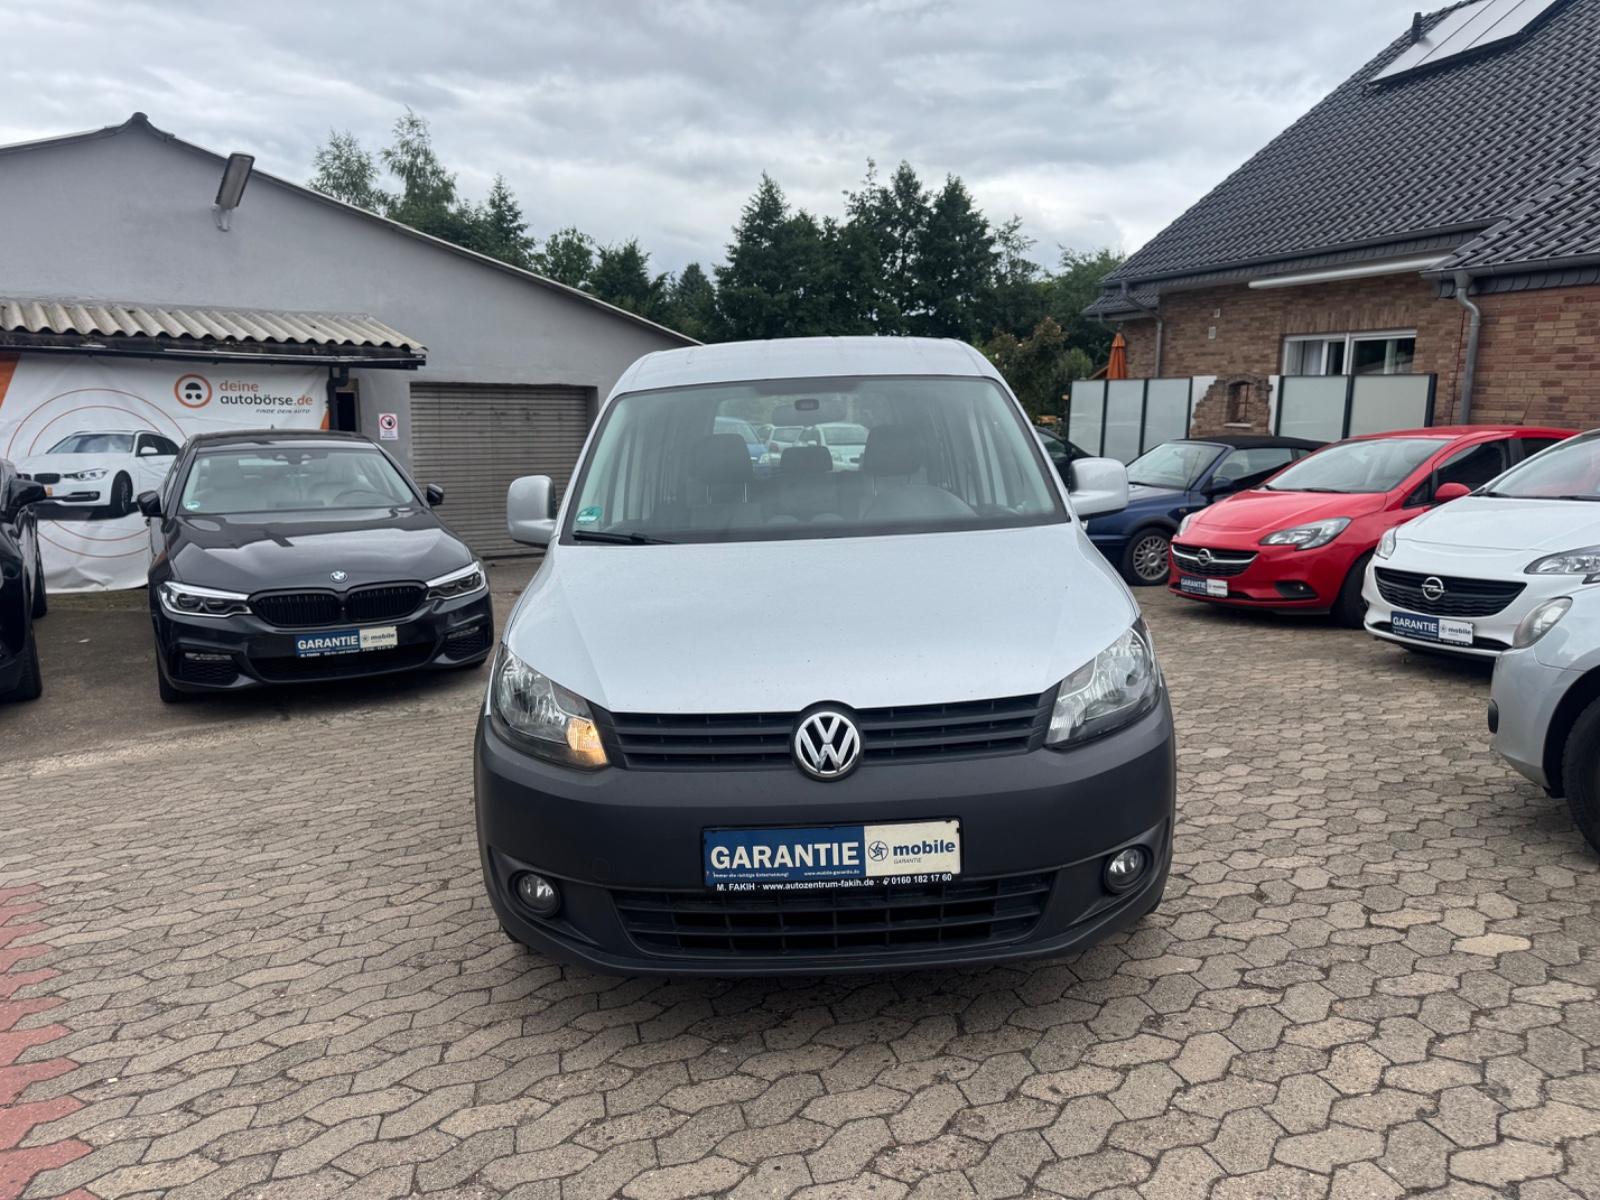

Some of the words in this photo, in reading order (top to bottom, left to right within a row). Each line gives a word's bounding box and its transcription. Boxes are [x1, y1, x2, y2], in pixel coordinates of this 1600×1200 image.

[219, 380, 259, 392] deine
[220, 393, 313, 406] autobörse.de
[1393, 616, 1438, 633] GARANTIE
[1448, 627, 1472, 635] mobile
[297, 635, 358, 650] GARANTIE
[370, 632, 395, 640] mobile
[893, 839, 956, 856] mobile
[710, 842, 859, 869] GARANTIE
[729, 883, 755, 891] FAKIH
[763, 879, 874, 890] www.autozentrum-fakih.de
[891, 876, 911, 884] 0160
[914, 875, 928, 883] 182
[931, 874, 940, 882] 17
[942, 873, 952, 881] 60
